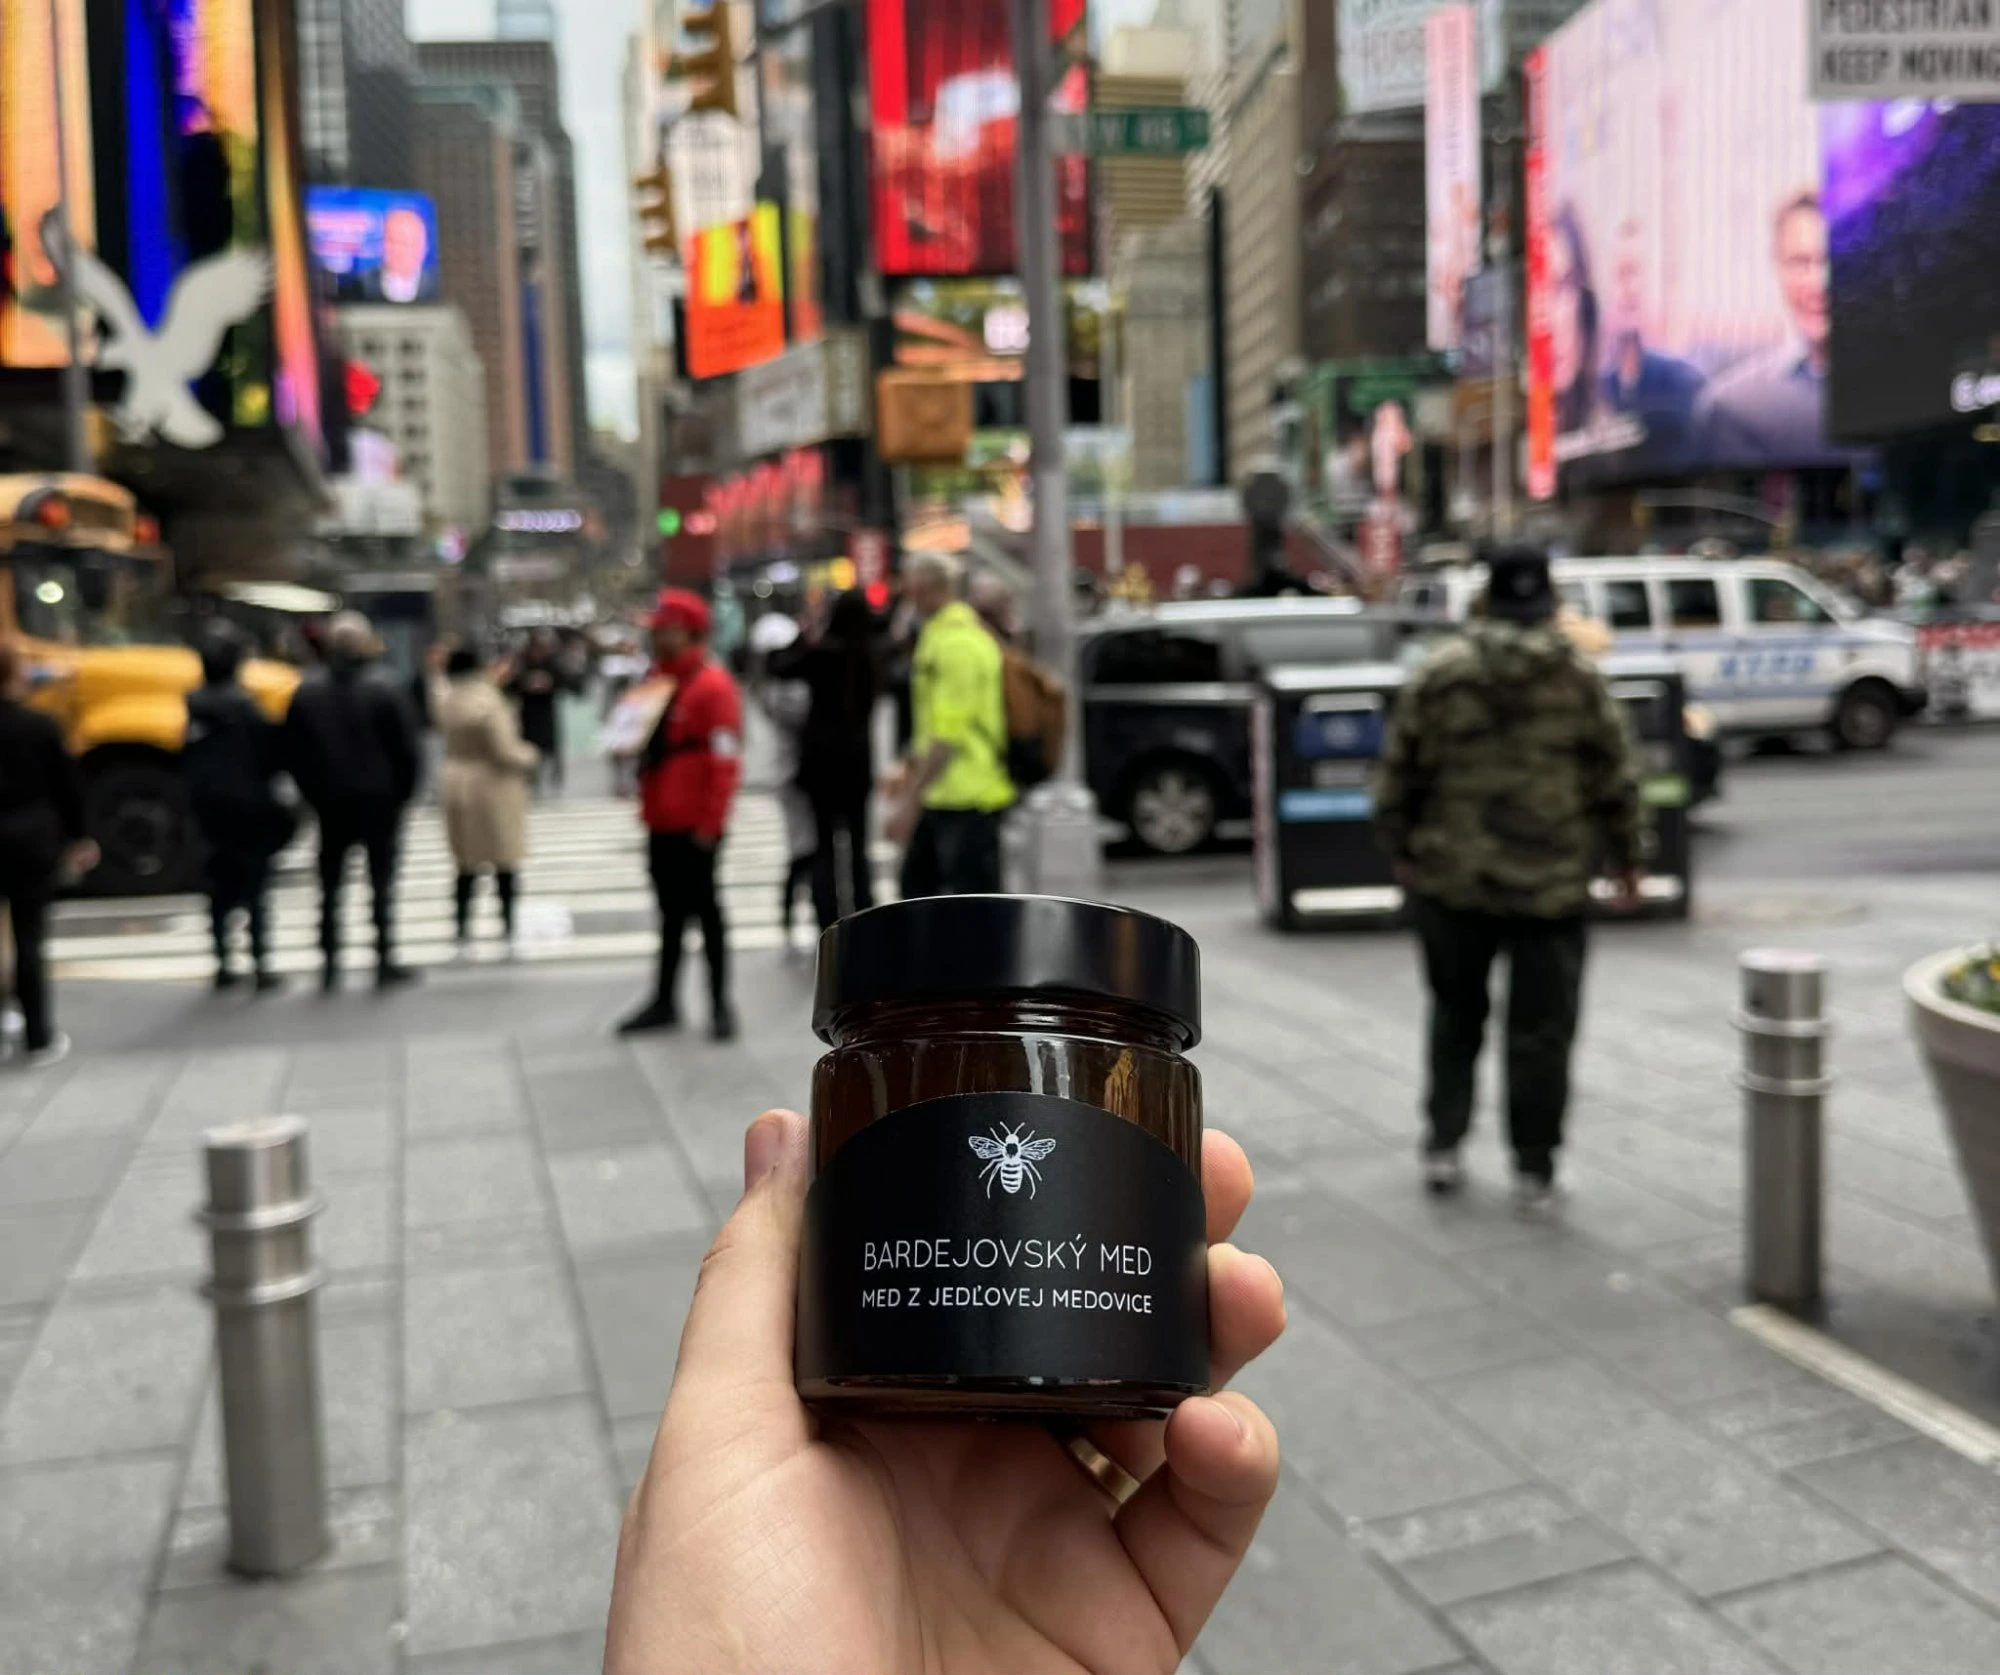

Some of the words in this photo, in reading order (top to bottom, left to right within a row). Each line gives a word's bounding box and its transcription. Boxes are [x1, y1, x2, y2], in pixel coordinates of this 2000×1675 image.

[1822, 46, 1889, 84] KEEP
[1902, 45, 2000, 83] MOVING
[864, 1233, 1087, 1271] BARDEJOVSKÝ
[1101, 1244, 1152, 1276] MED
[862, 1288, 900, 1308] MED
[907, 1287, 921, 1307] Z
[1052, 1289, 1152, 1314] MEDOVICE
